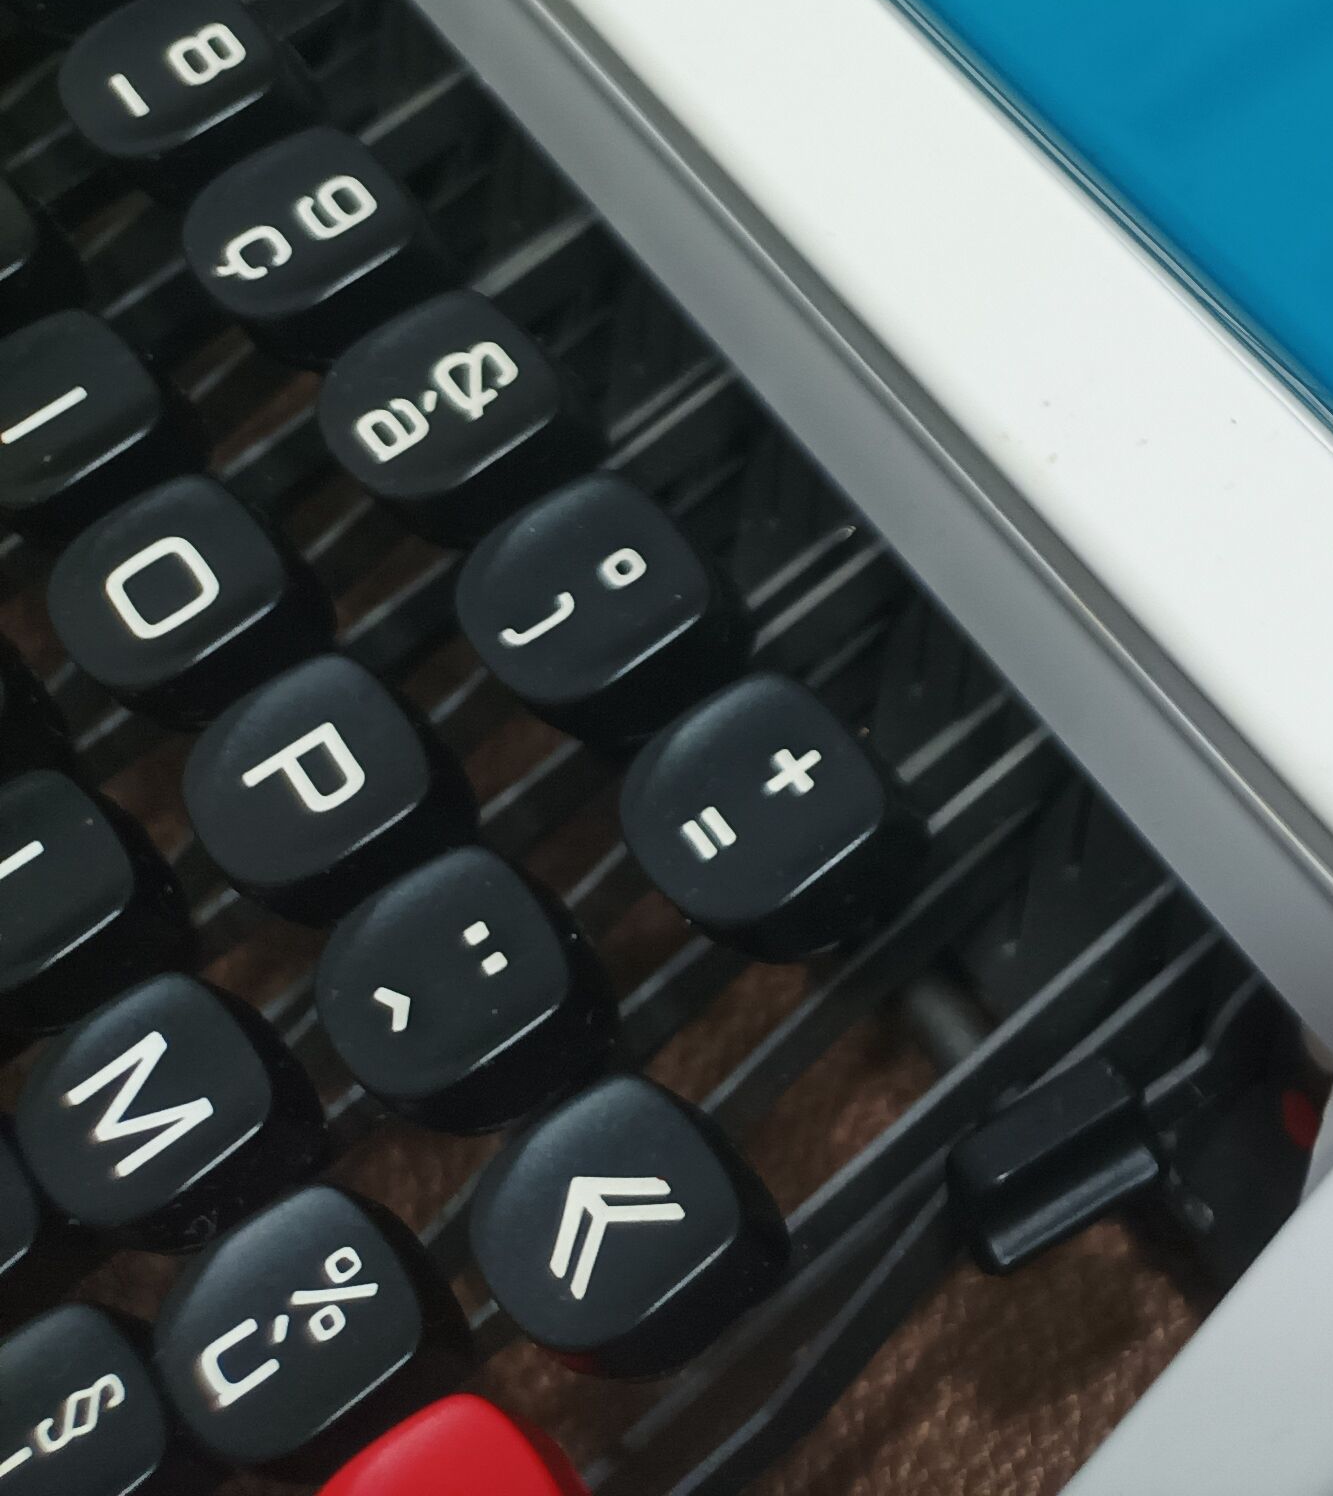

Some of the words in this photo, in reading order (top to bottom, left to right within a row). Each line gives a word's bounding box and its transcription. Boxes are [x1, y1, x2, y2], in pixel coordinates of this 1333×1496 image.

[166, 22, 247, 86] 8
[295, 175, 378, 240] 9
[432, 341, 519, 421] &
[241, 722, 366, 813] P
[765, 748, 822, 795] +
[681, 806, 737, 860] =
[65, 1030, 214, 1178] M
[290, 1246, 379, 1342] %
[34, 1373, 125, 1454] §
